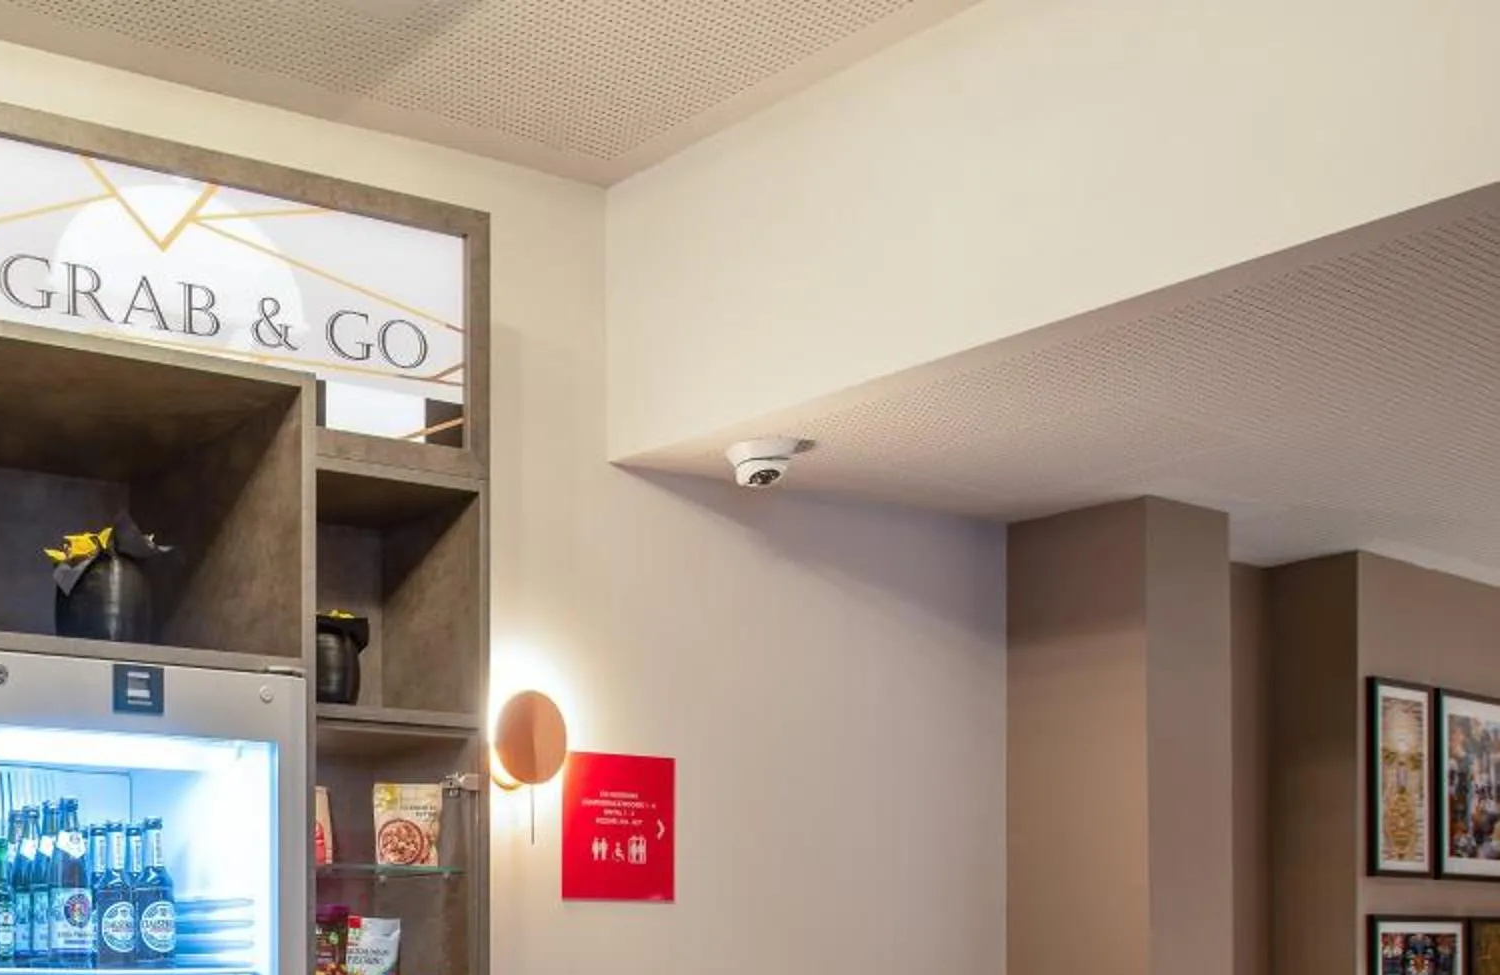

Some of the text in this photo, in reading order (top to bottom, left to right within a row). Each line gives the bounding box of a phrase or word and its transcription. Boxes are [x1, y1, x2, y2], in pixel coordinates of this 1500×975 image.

[0, 253, 429, 370] GRAB & GO
